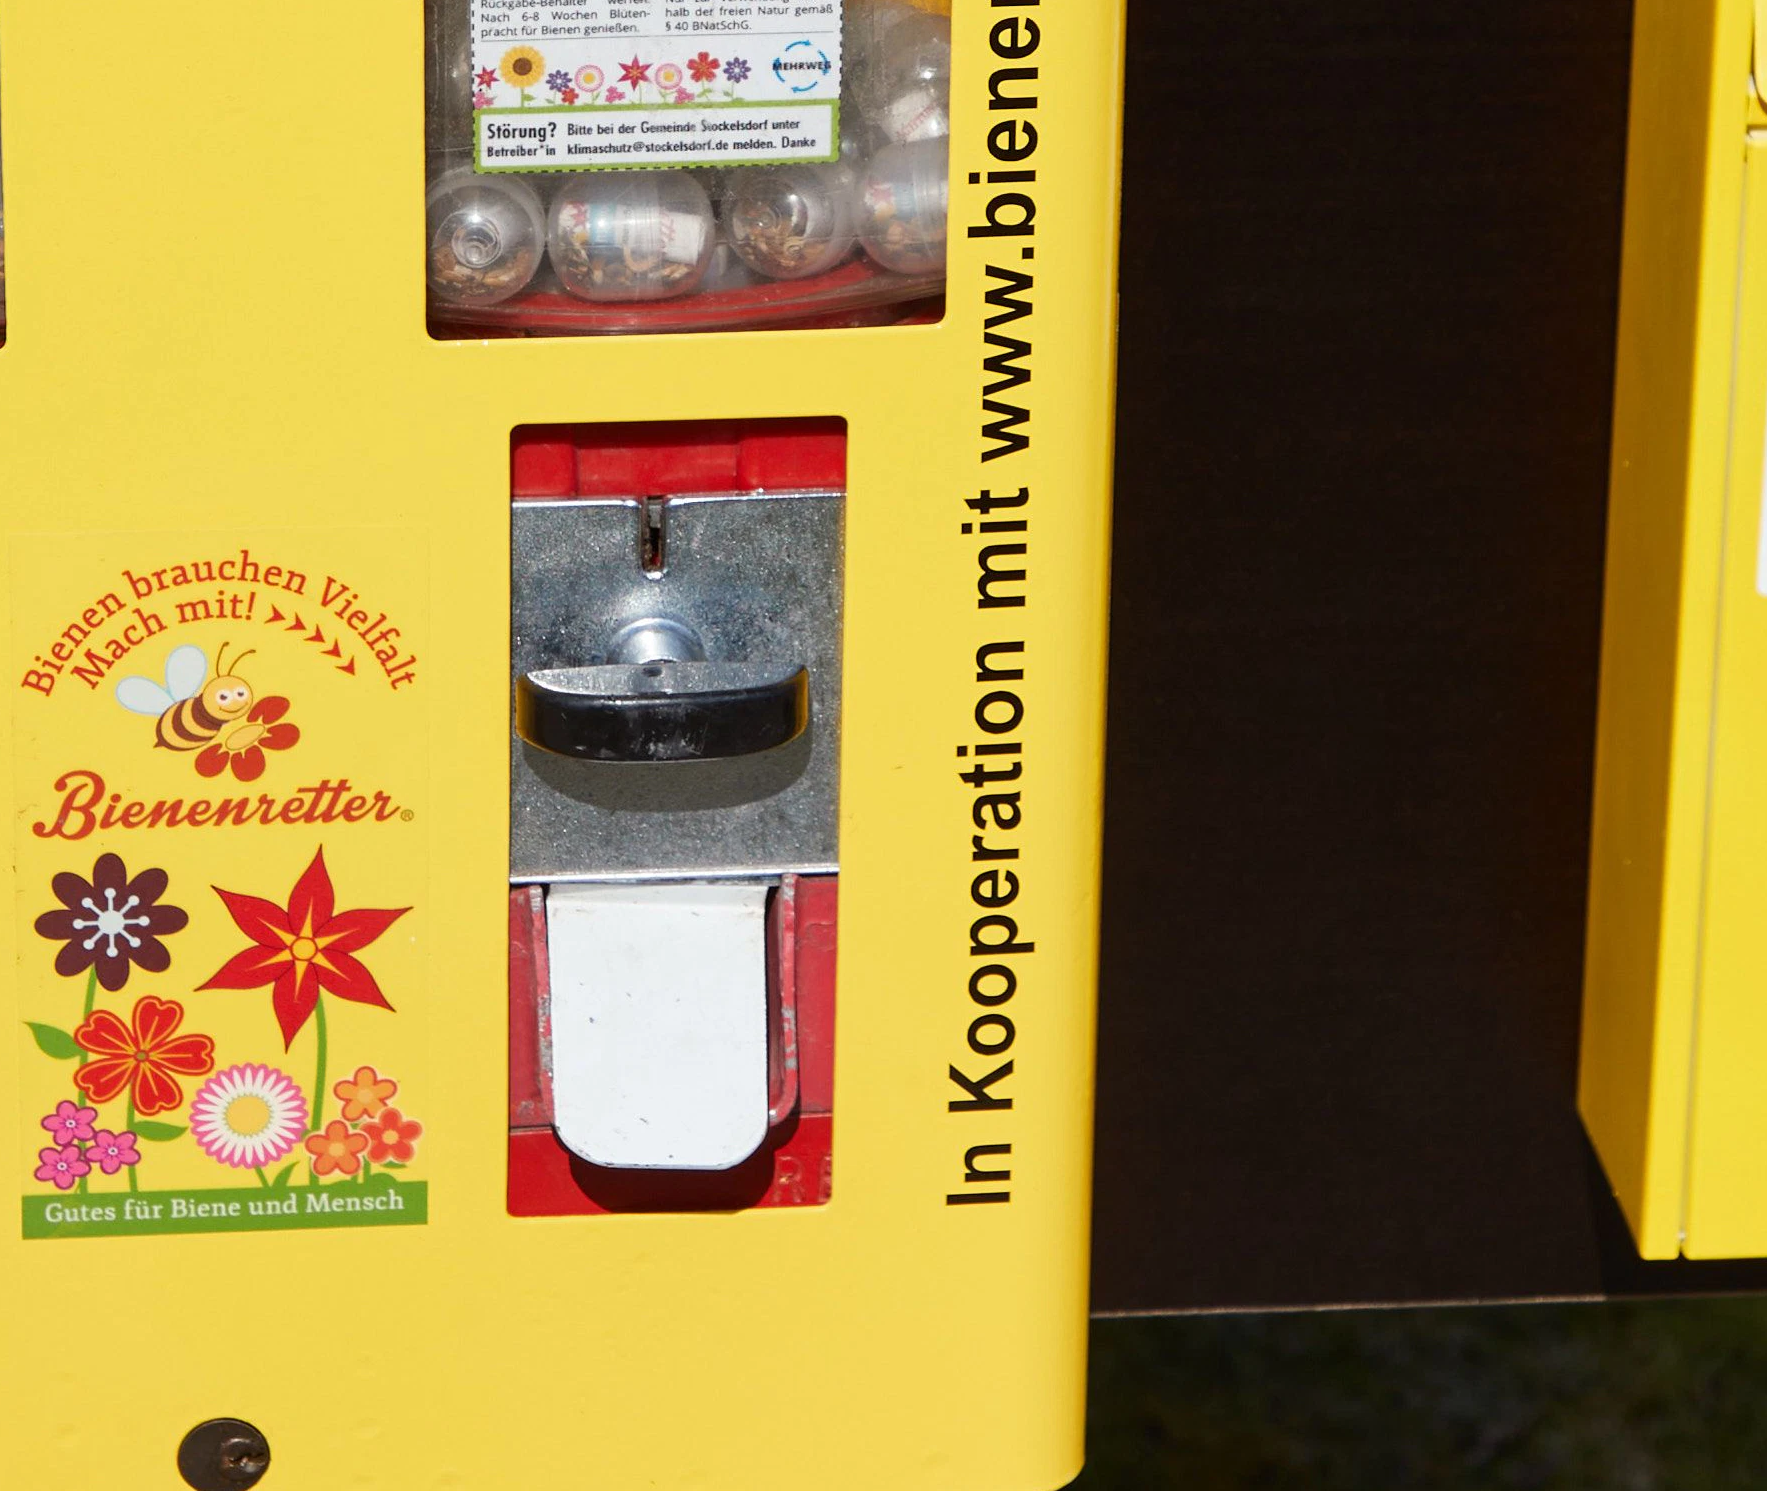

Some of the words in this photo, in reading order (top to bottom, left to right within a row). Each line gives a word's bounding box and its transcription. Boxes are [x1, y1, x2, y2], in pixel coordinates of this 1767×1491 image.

[772, 60, 831, 72] MEHRWEG
[487, 122, 557, 141] Störung?
[567, 122, 593, 136] Bitte
[596, 124, 614, 135] bei
[617, 123, 637, 135] der
[640, 120, 697, 134] Gemeinde
[771, 119, 801, 130] unter
[732, 138, 777, 150] melden.
[781, 135, 816, 149] Danke
[961, 487, 1029, 609] mit
[21, 591, 127, 696] Bienen
[122, 550, 307, 600] brauchen
[320, 576, 417, 690] Vielfalt
[71, 608, 167, 690] Mach
[176, 591, 256, 624] mit!
[948, 641, 1035, 1112] Kooperation
[946, 1143, 1012, 1205] In
[44, 1202, 117, 1223] Gutes
[124, 1198, 163, 1220] für
[170, 1198, 241, 1219] Biene
[248, 1192, 298, 1216] und
[305, 1188, 404, 1213] Mensch
